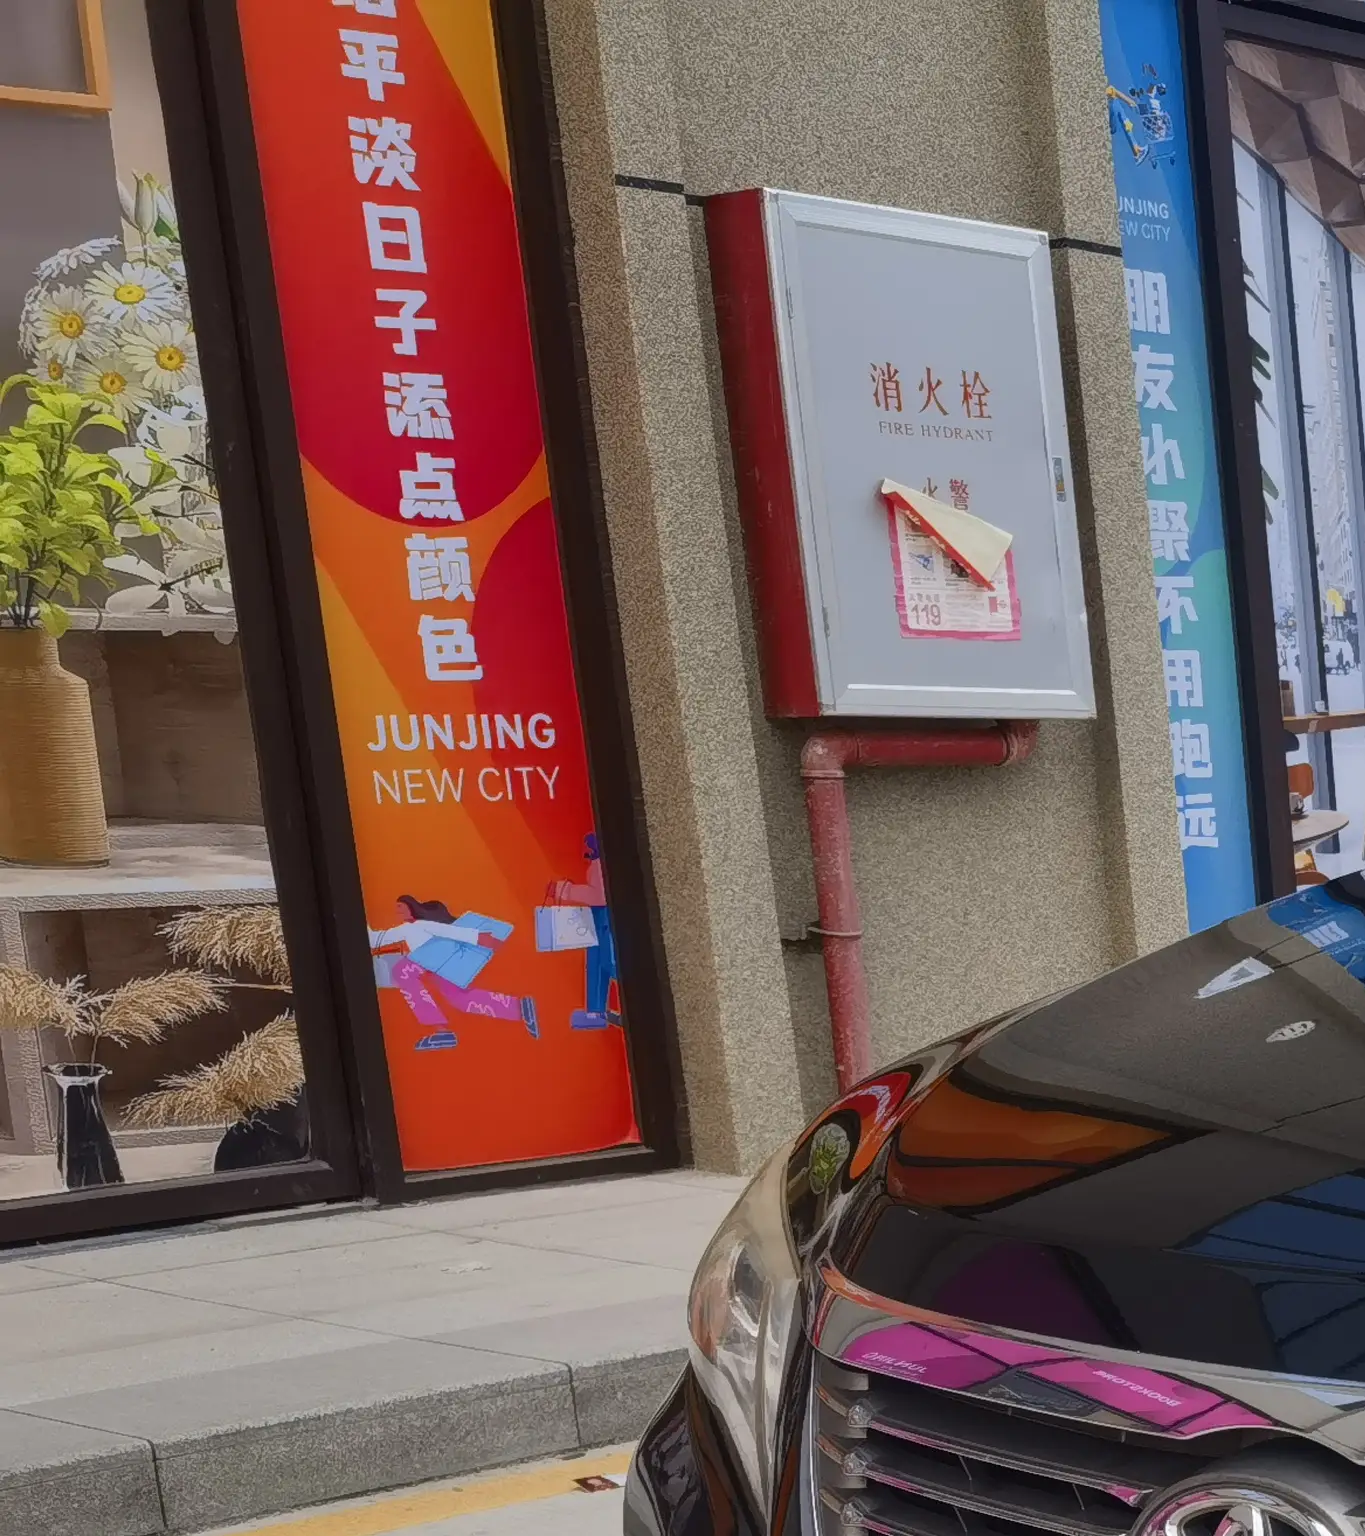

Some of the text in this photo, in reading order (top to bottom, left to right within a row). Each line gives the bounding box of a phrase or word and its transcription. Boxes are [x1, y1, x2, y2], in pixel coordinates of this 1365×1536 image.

[1141, 223, 1171, 242] CITY
[332, 0, 483, 681] 平淡日子添点颜色
[869, 361, 992, 419] 消火栓
[878, 420, 993, 442] FIRE HYDRANT
[1123, 267, 1219, 850] 朋友小聚不用跑远
[910, 604, 943, 627] 119
[367, 713, 556, 751] JUNJING
[373, 766, 560, 804] NEW CITY
